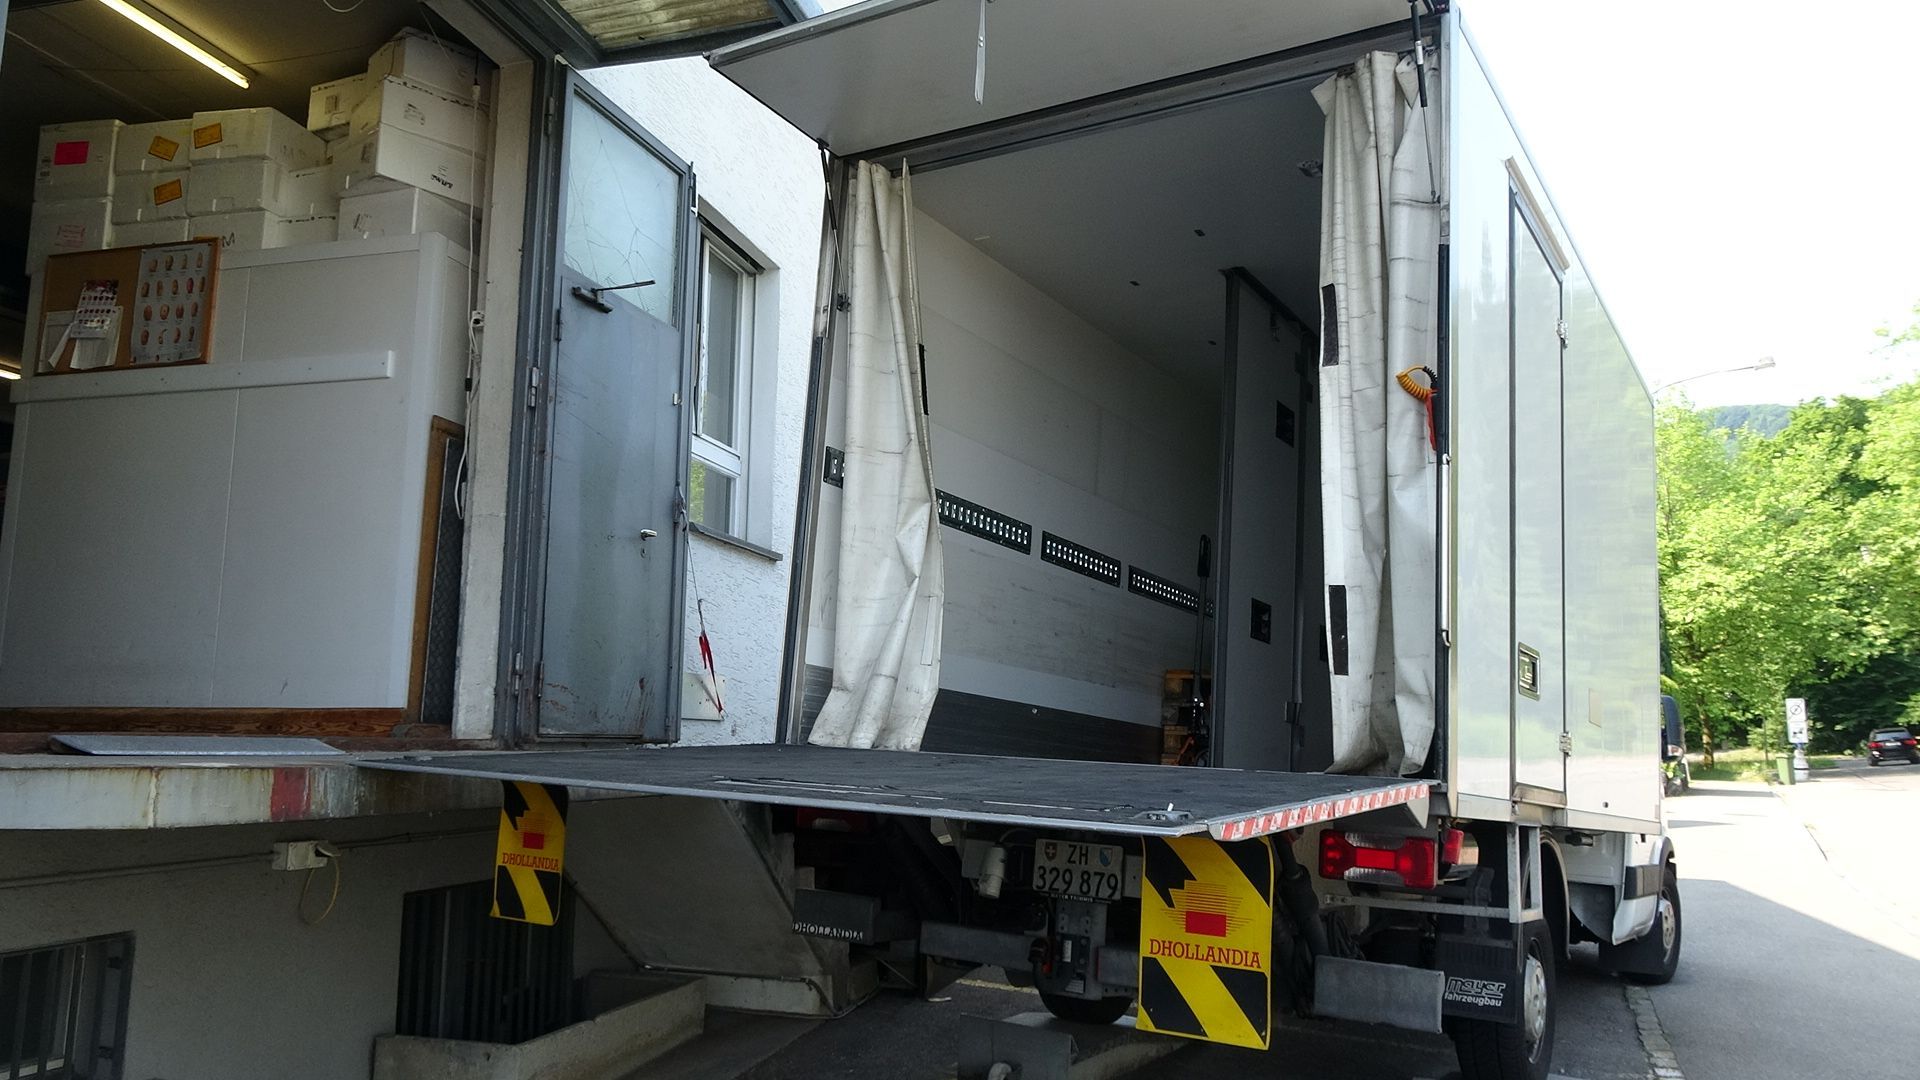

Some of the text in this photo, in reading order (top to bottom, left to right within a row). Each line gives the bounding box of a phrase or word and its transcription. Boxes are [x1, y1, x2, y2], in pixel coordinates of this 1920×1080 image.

[502, 853, 561, 872] DHOLLANDIA
[1067, 844, 1089, 865] ZH
[1036, 866, 1119, 899] 329 879
[792, 922, 864, 940] DHOLLANDIA
[1149, 939, 1262, 969] DHOLLANDIA
[1444, 992, 1502, 1007] fahrzeugbau
